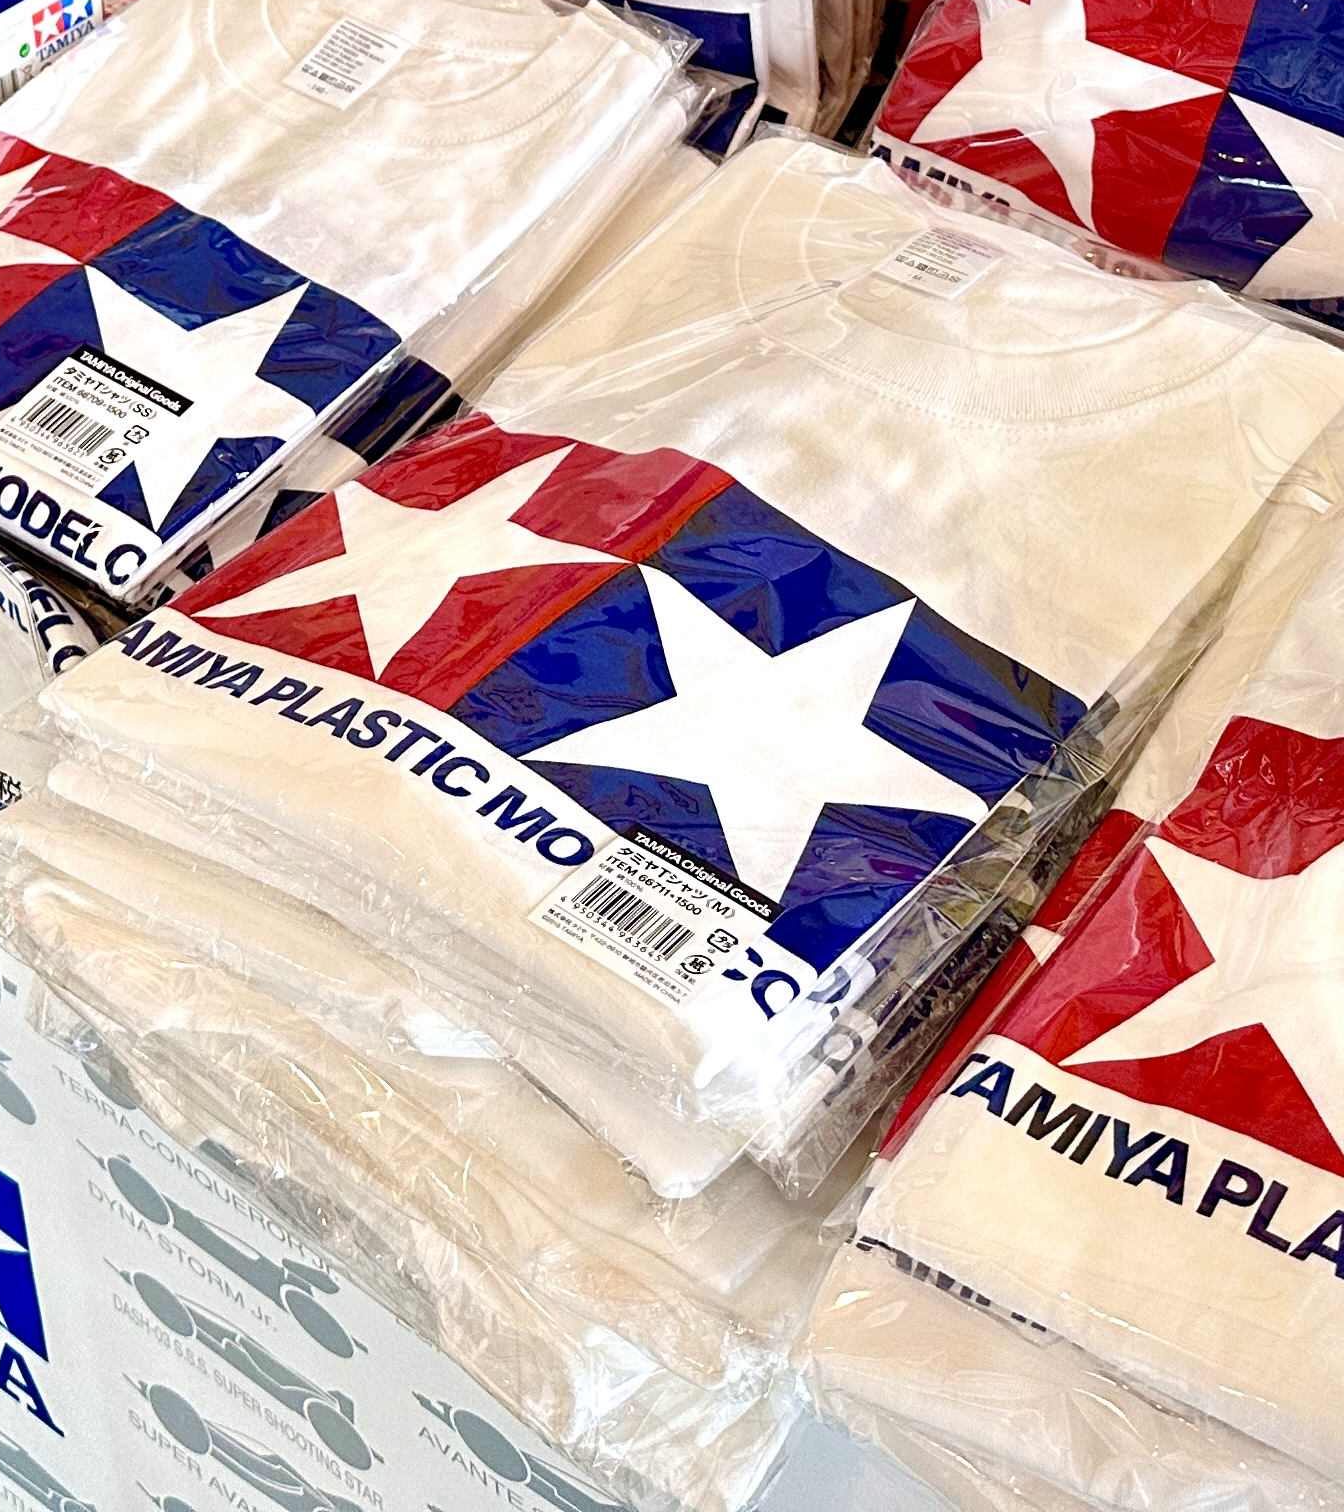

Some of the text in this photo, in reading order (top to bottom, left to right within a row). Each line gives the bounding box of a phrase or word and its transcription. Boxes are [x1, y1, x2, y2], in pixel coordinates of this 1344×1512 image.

[34, 19, 96, 64] TAMIYA
[53, 376, 79, 394] ITEM
[80, 350, 183, 412] TAMIYA Original Goods
[261, 679, 494, 803] PLASTIC
[478, 781, 596, 869] MO
[607, 855, 638, 877] ITEM
[634, 832, 772, 918] TAMIYA Original Goods
[56, 1064, 311, 1261] TERRA CONQUEROR
[88, 1180, 281, 1333] DYNA STORM Jr.
[128, 1408, 203, 1480] SUPER
[214, 1366, 264, 1423] SUPER
[264, 1405, 342, 1480] SHOOTING
[341, 1464, 385, 1511] STAR
[418, 1425, 526, 1511] AVANTE
